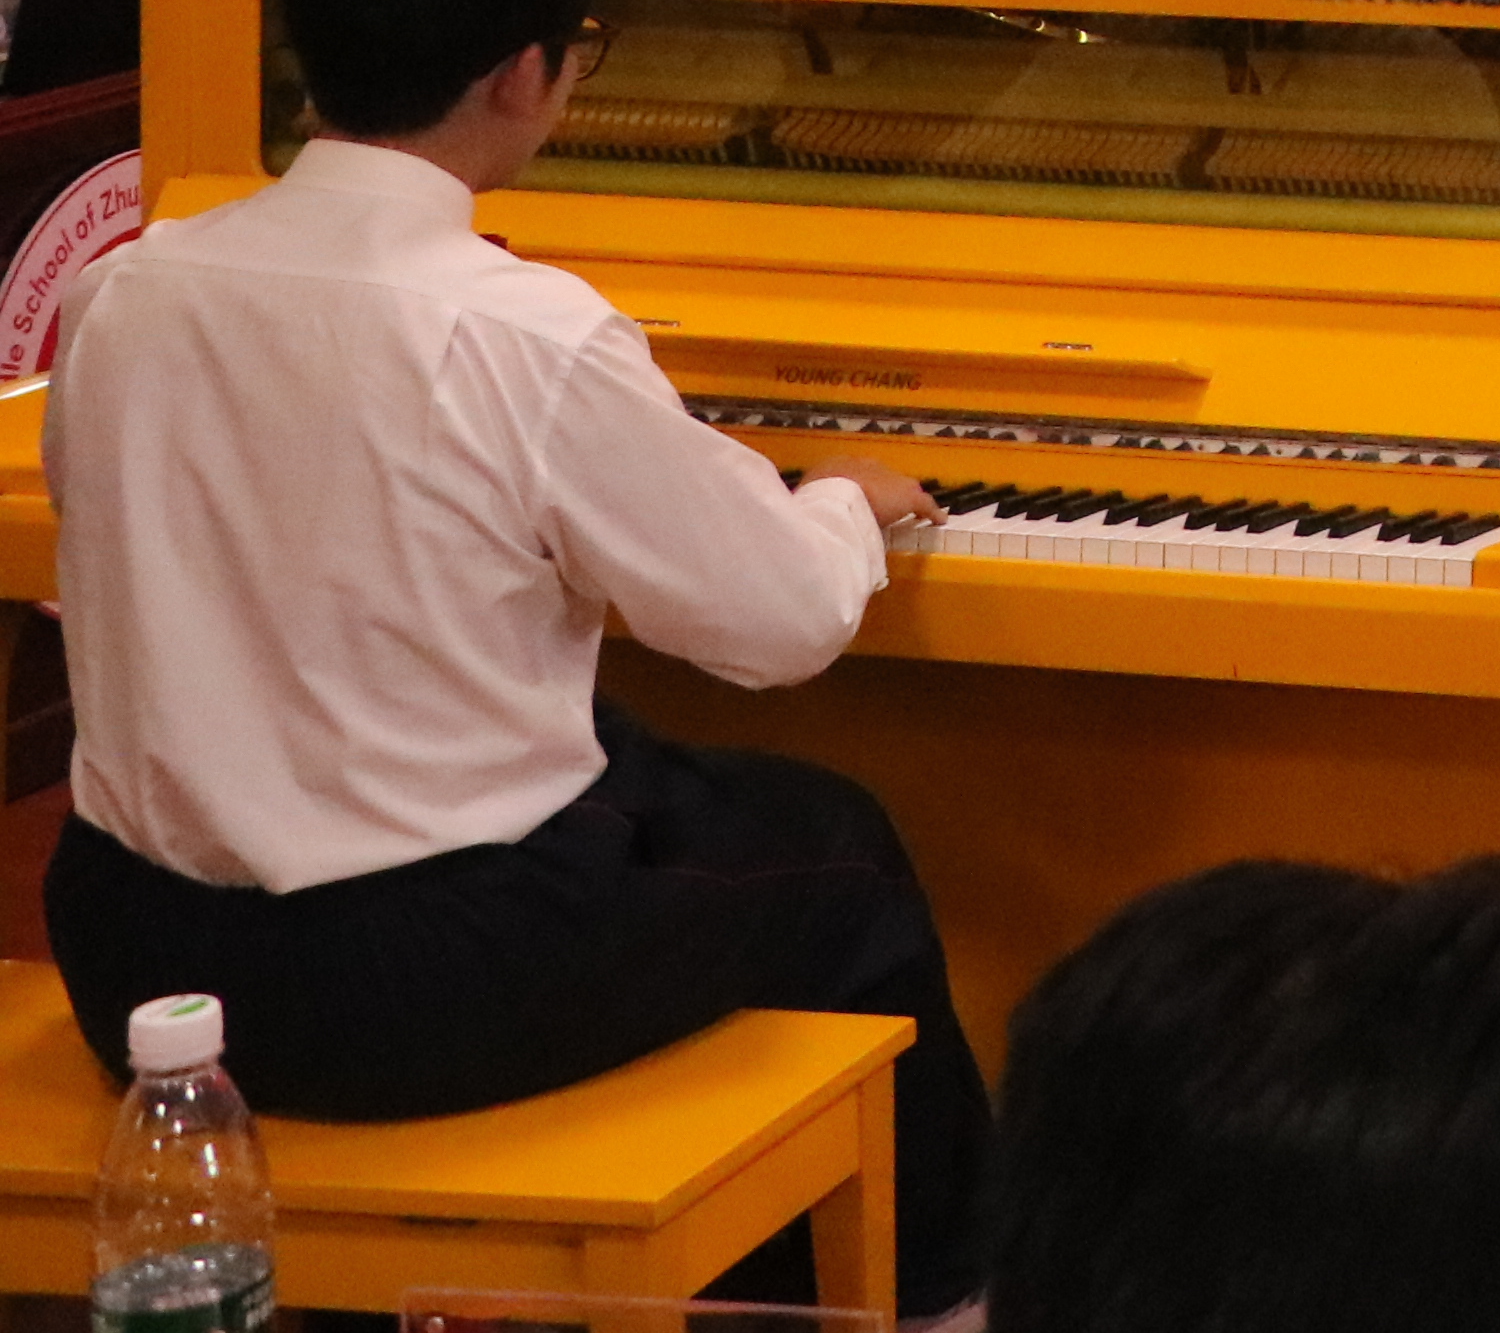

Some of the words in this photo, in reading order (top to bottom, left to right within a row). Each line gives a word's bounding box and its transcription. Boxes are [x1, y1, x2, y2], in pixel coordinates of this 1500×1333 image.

[13, 232, 75, 334] School
[75, 202, 95, 241] of
[774, 365, 844, 387] YOUNG
[848, 369, 922, 391] CHANG
